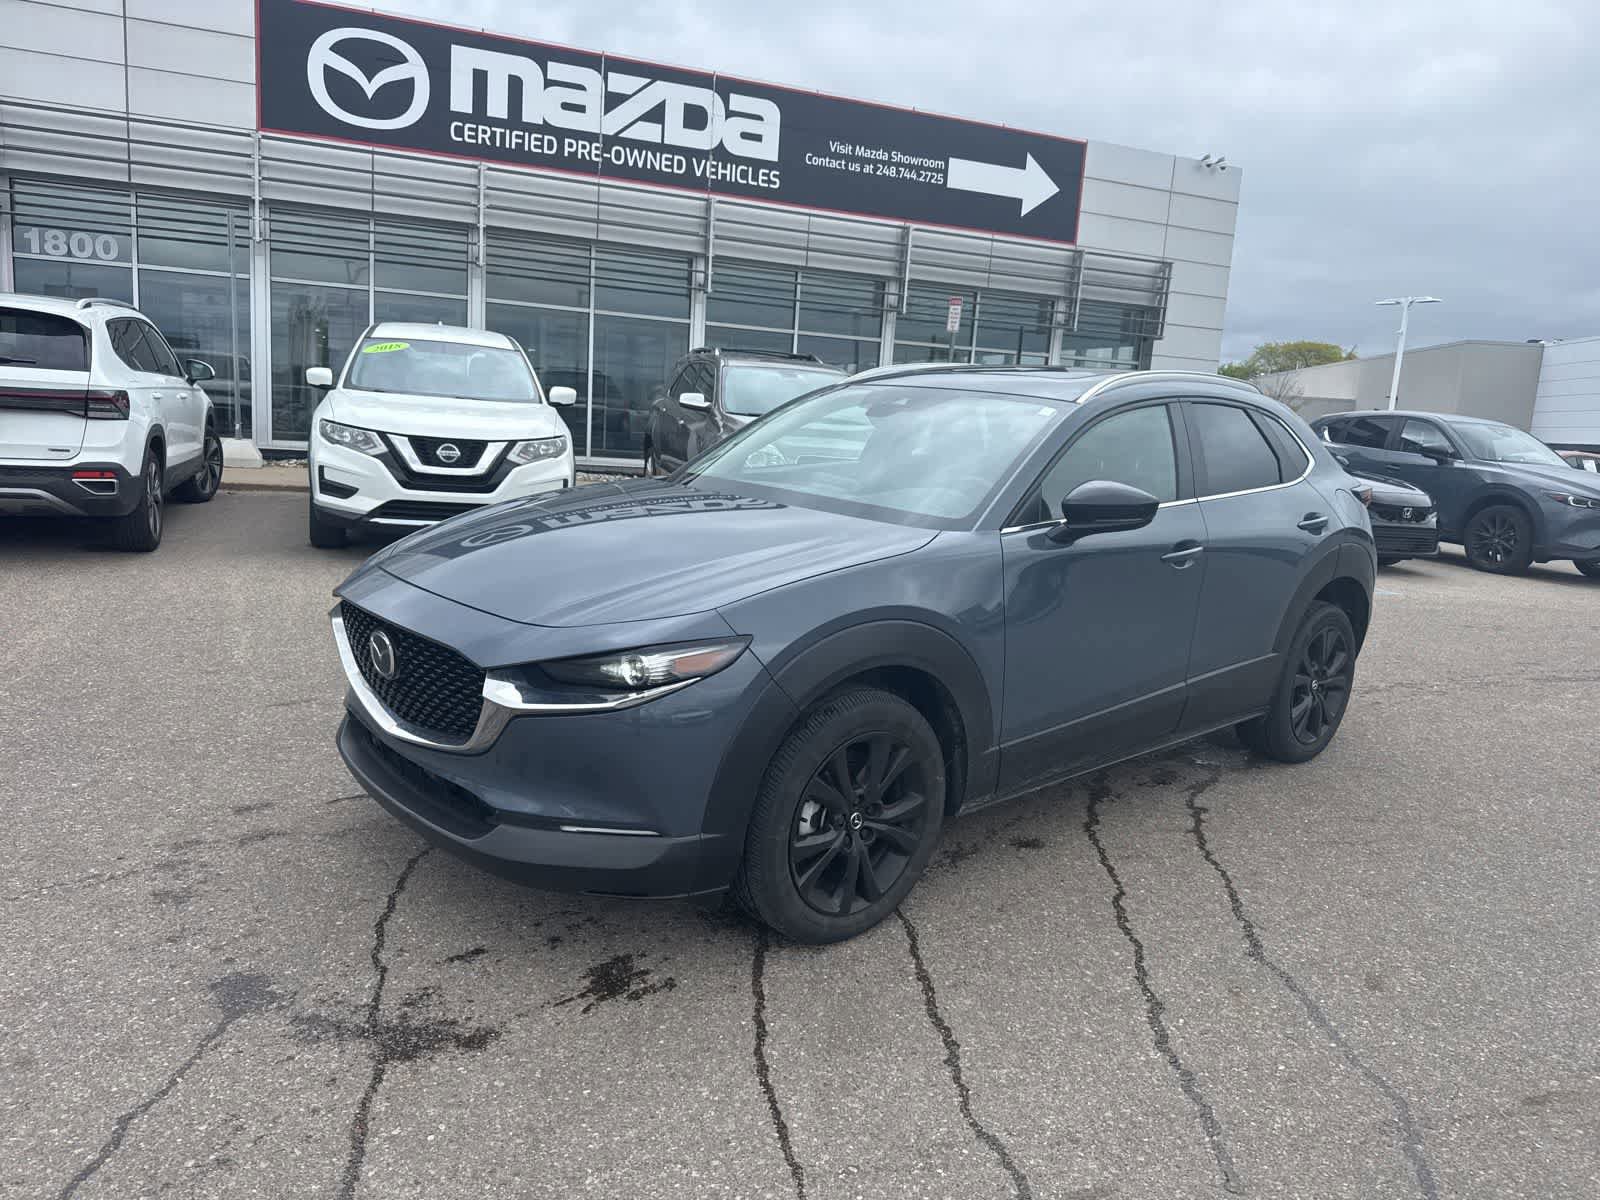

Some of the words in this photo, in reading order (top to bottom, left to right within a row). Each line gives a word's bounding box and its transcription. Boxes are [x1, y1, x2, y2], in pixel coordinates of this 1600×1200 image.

[450, 121, 557, 154] CERTIFIED
[564, 138, 686, 174] PRE-OWNED
[692, 158, 780, 189] VEHICLES
[806, 153, 846, 170] Contact
[848, 162, 861, 172] us
[863, 163, 874, 174] at
[876, 164, 944, 184] 248.744.2725
[829, 140, 852, 155] Visit
[855, 144, 888, 160] Mazda
[890, 150, 945, 169] Showroom
[24, 227, 119, 260] 1800
